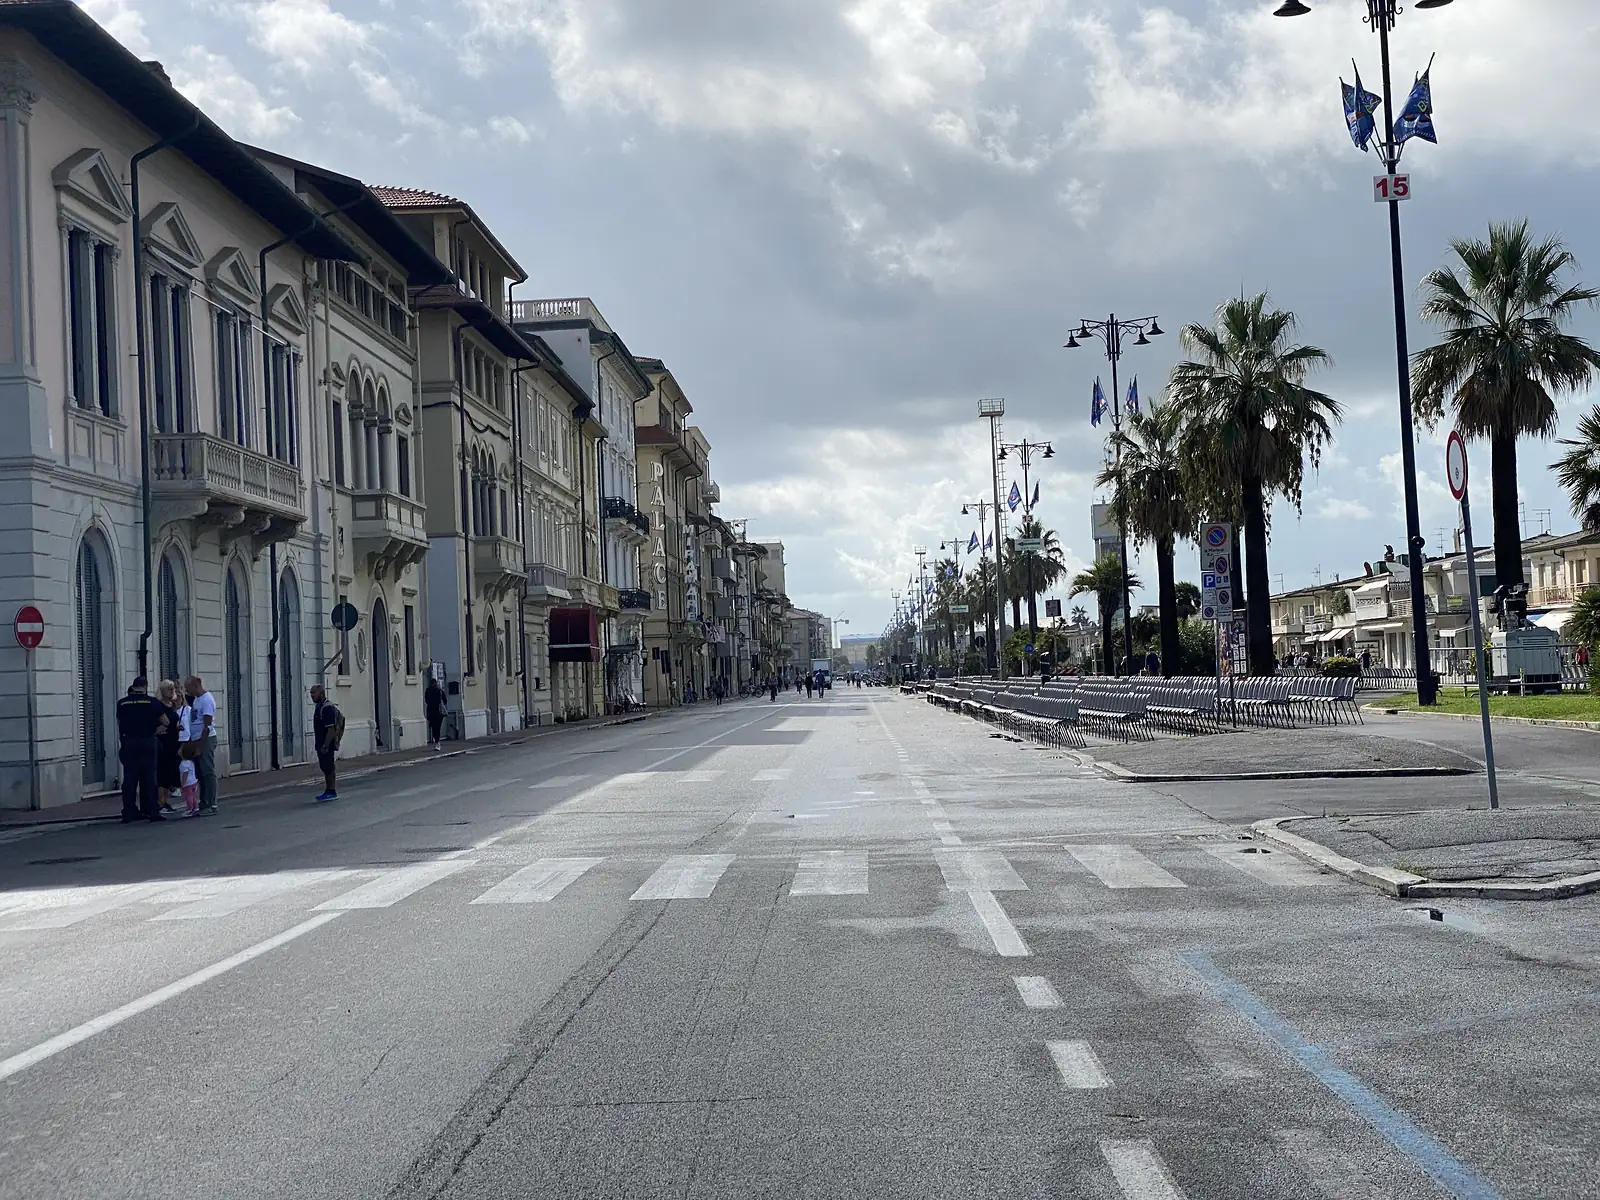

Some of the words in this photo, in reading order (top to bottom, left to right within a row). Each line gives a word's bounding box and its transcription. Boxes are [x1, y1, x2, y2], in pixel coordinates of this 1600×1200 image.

[1376, 177, 1409, 198] 15
[650, 461, 668, 610] PALACE
[682, 524, 697, 621] MIRAMARE
[1205, 576, 1214, 587] P
